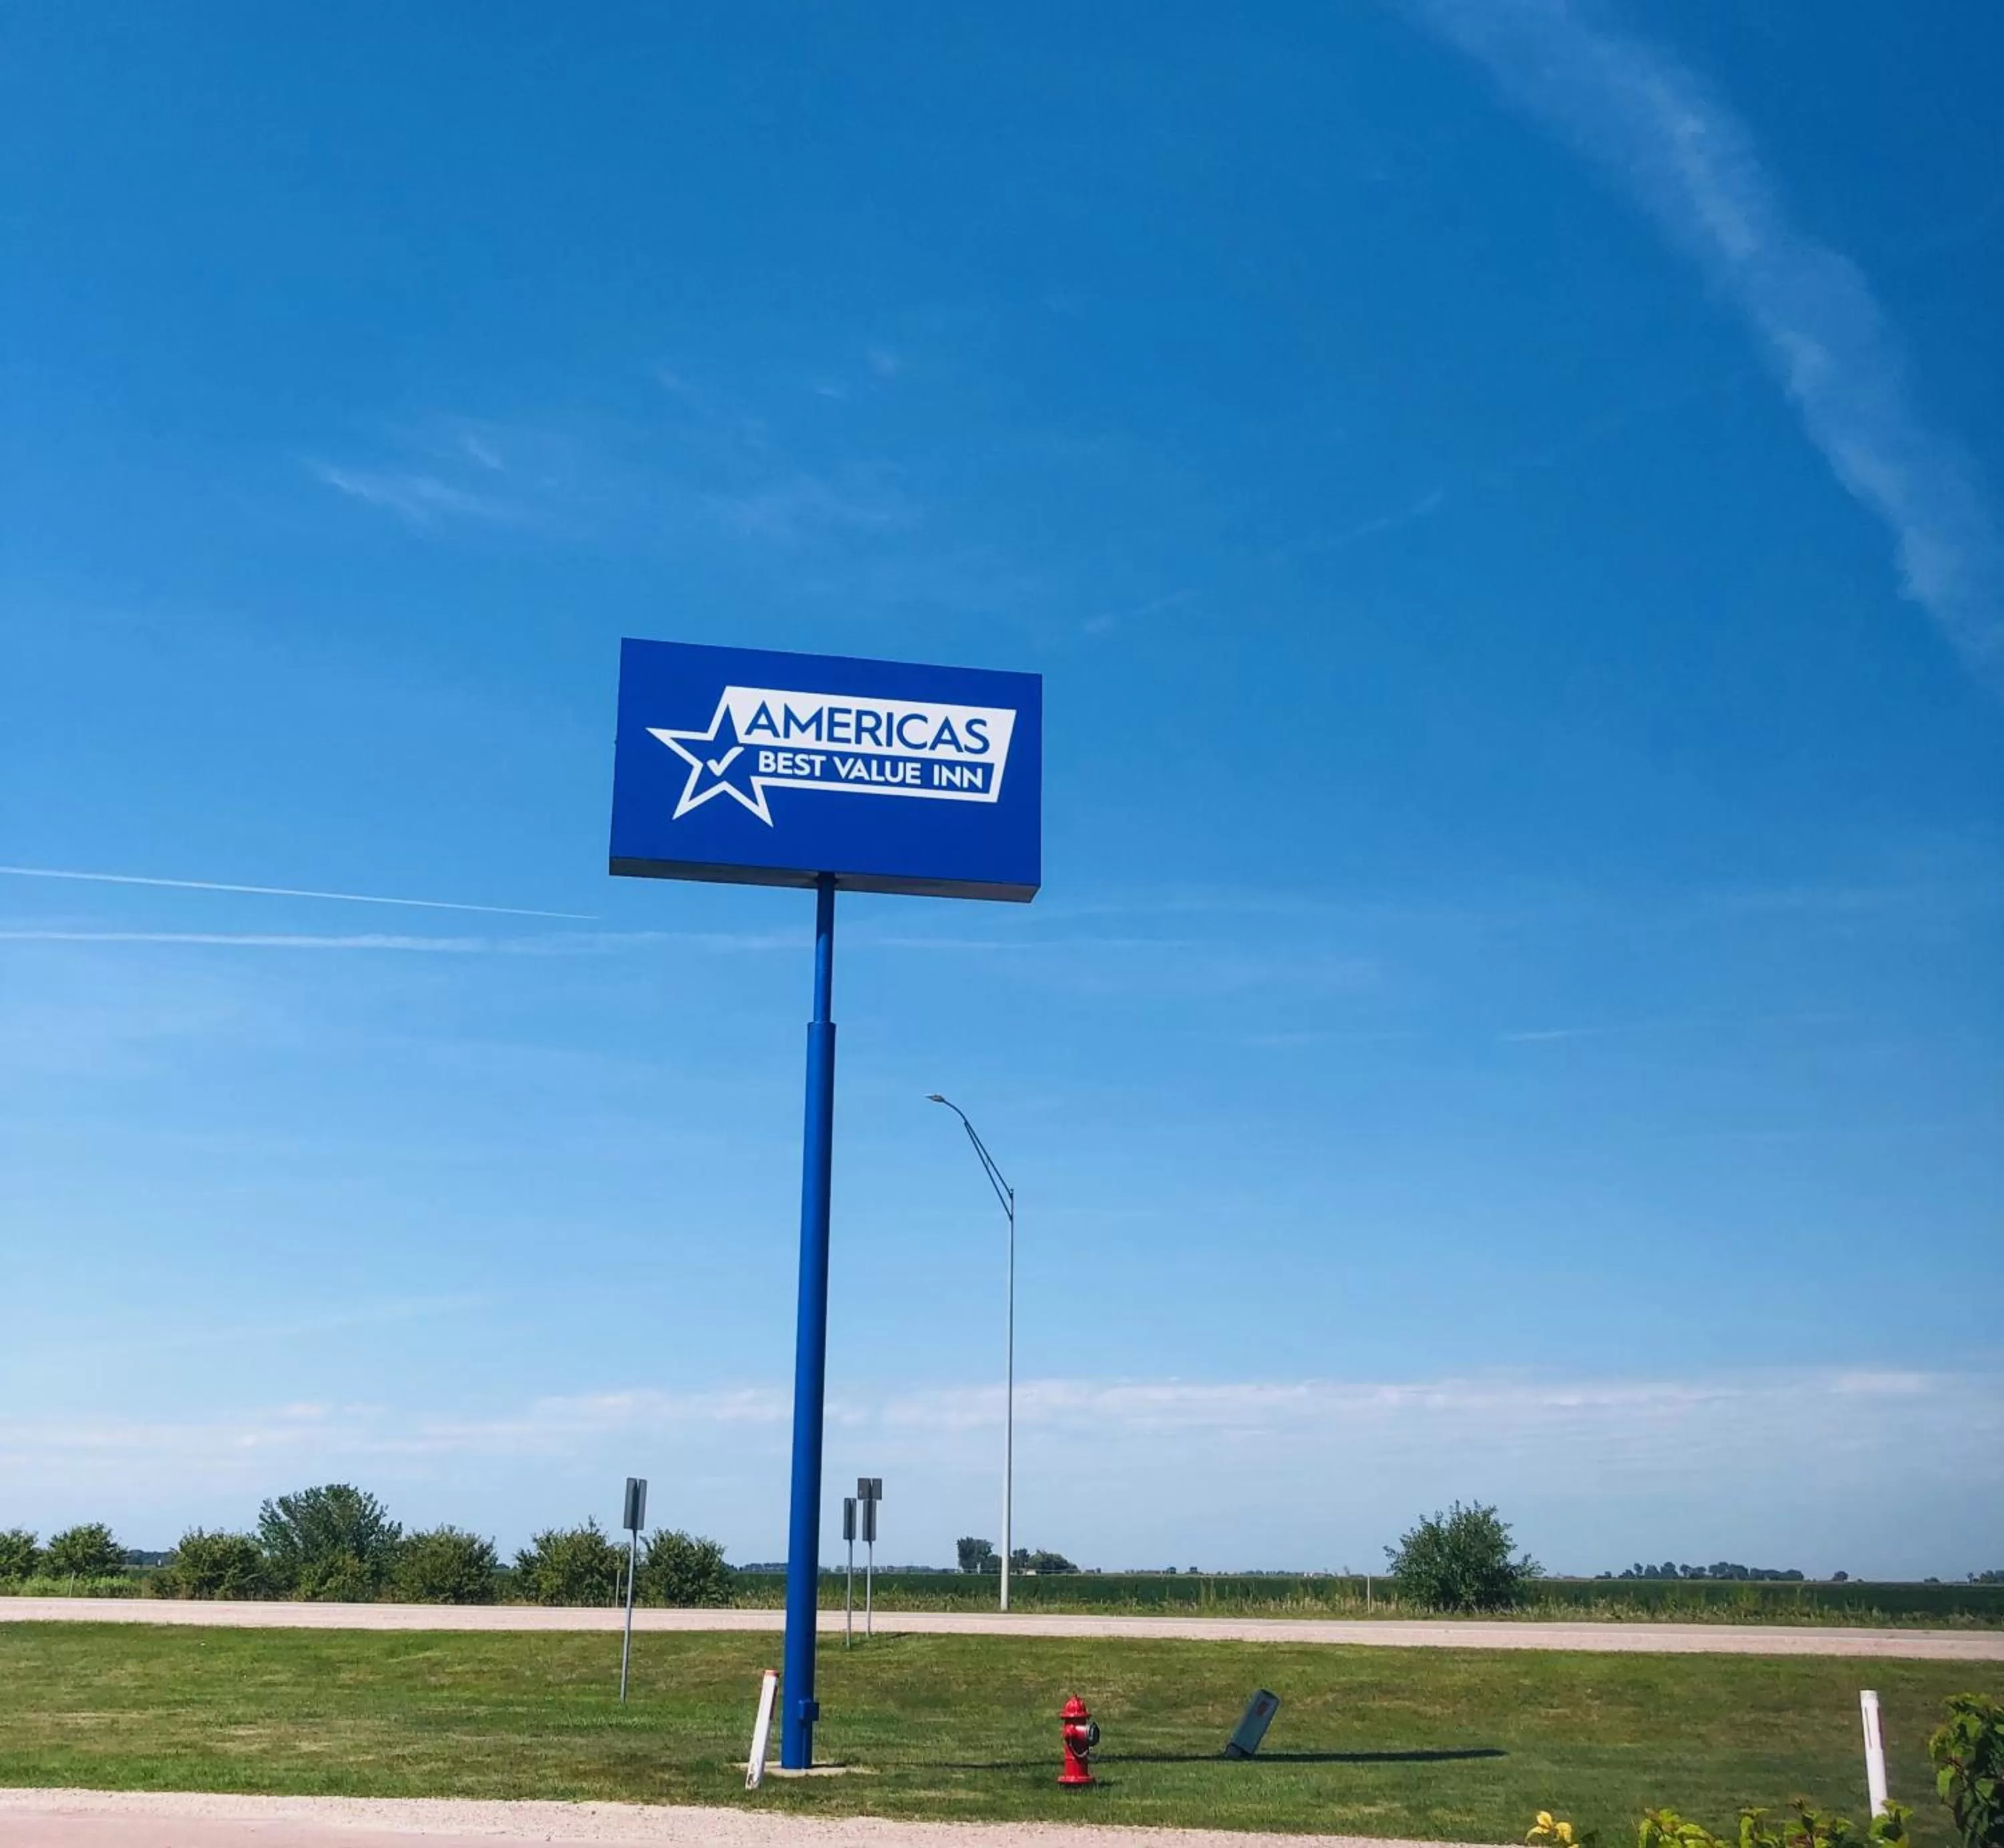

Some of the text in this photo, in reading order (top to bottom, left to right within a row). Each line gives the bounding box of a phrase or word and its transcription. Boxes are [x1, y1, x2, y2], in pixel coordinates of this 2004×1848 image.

[743, 700, 990, 755] AMERICAS
[758, 751, 983, 790] BEST VALUE INN
